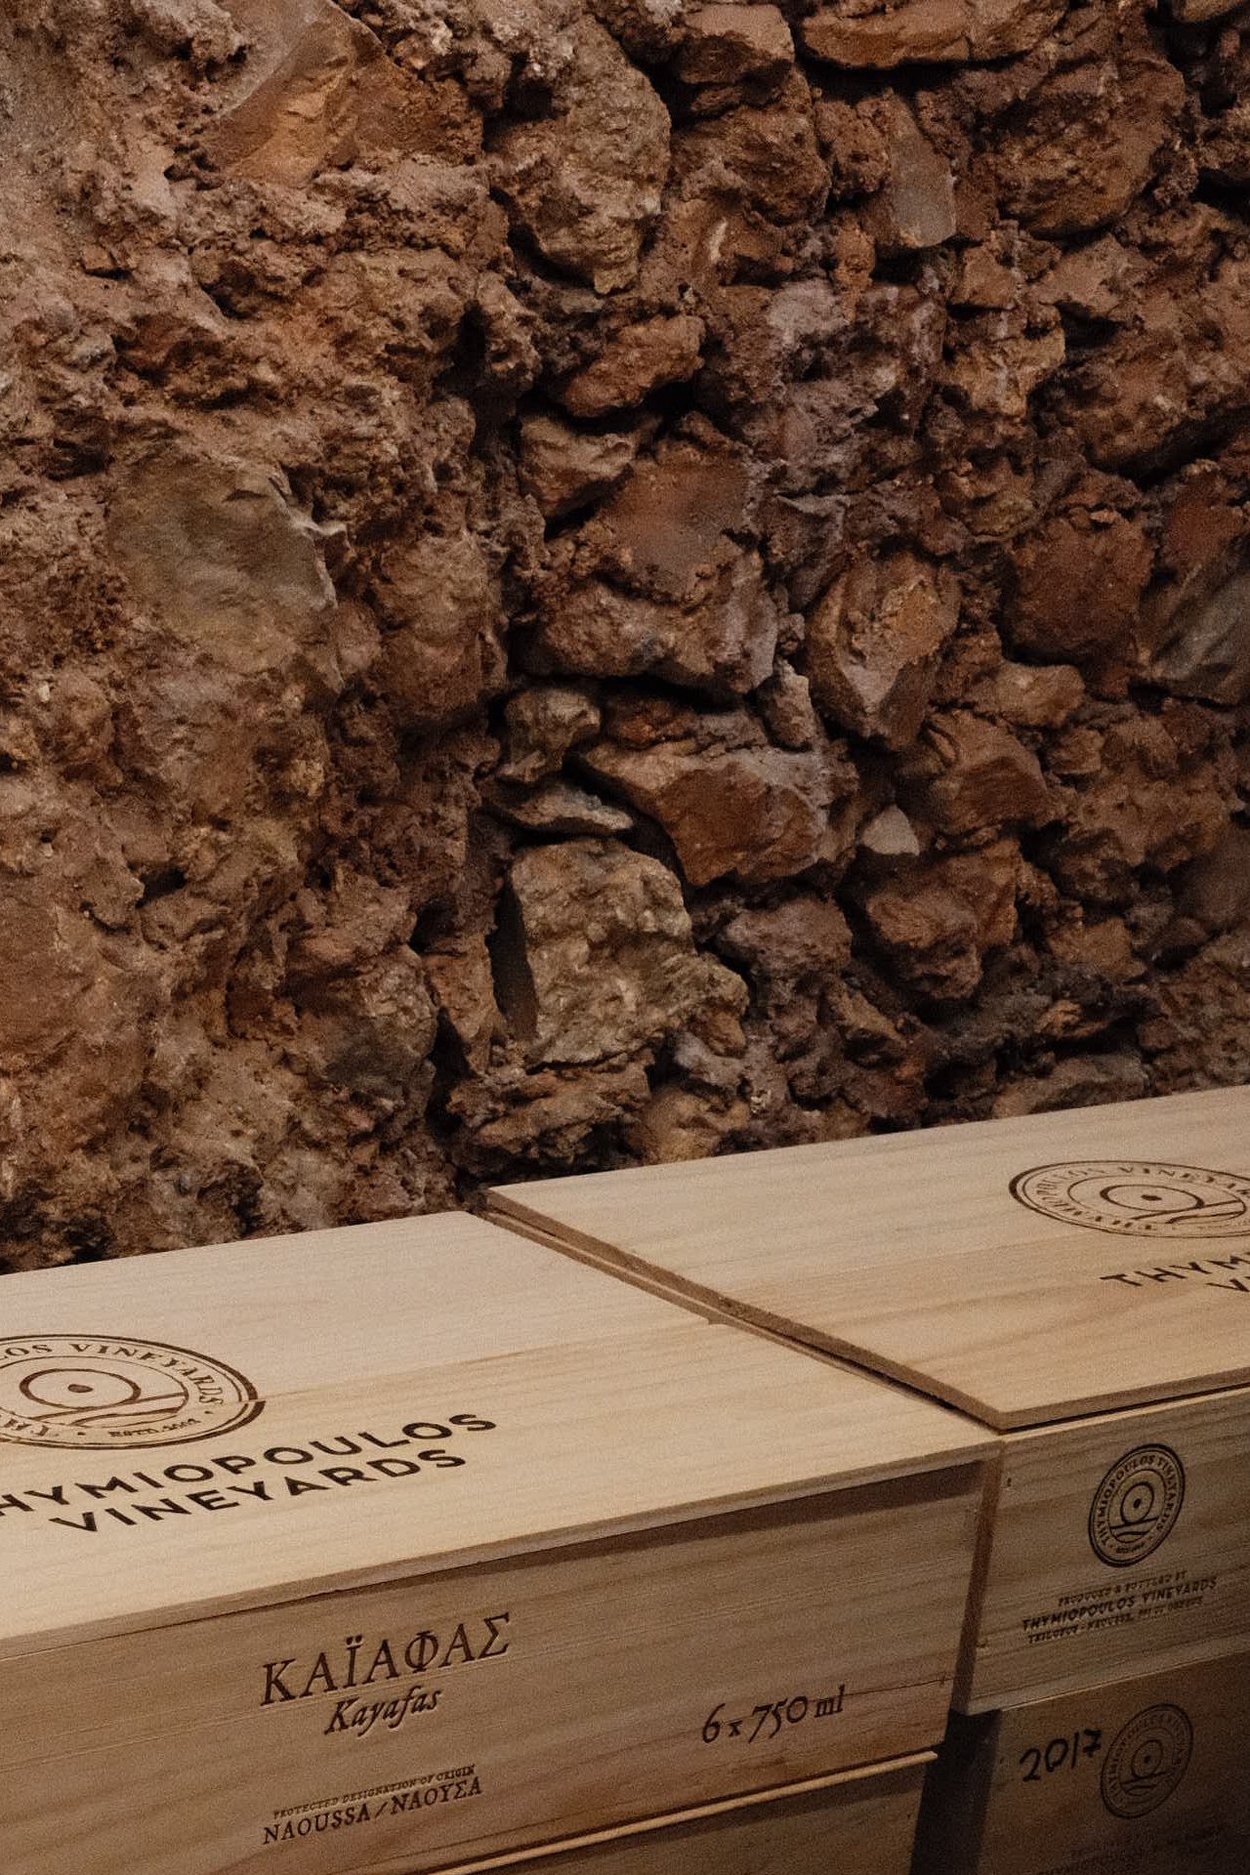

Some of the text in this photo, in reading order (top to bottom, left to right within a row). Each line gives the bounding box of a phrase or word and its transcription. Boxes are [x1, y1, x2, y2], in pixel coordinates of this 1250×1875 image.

[68, 1343, 223, 1408] VINEYARDS
[50, 1449, 466, 1533] VINEYARDS
[1021, 1595, 1135, 1632] THYMIOPOULOS
[1142, 1576, 1218, 1602] VINEYARDS
[260, 1612, 510, 1707] ΚΑΪΑΦΑΣ
[324, 1684, 442, 1737] Kayafas
[1019, 1728, 1103, 1782] 2017
[273, 1797, 339, 1819] PROTECTED
[342, 1778, 420, 1805] DESIGNATION
[435, 1763, 476, 1782] ORIGIN
